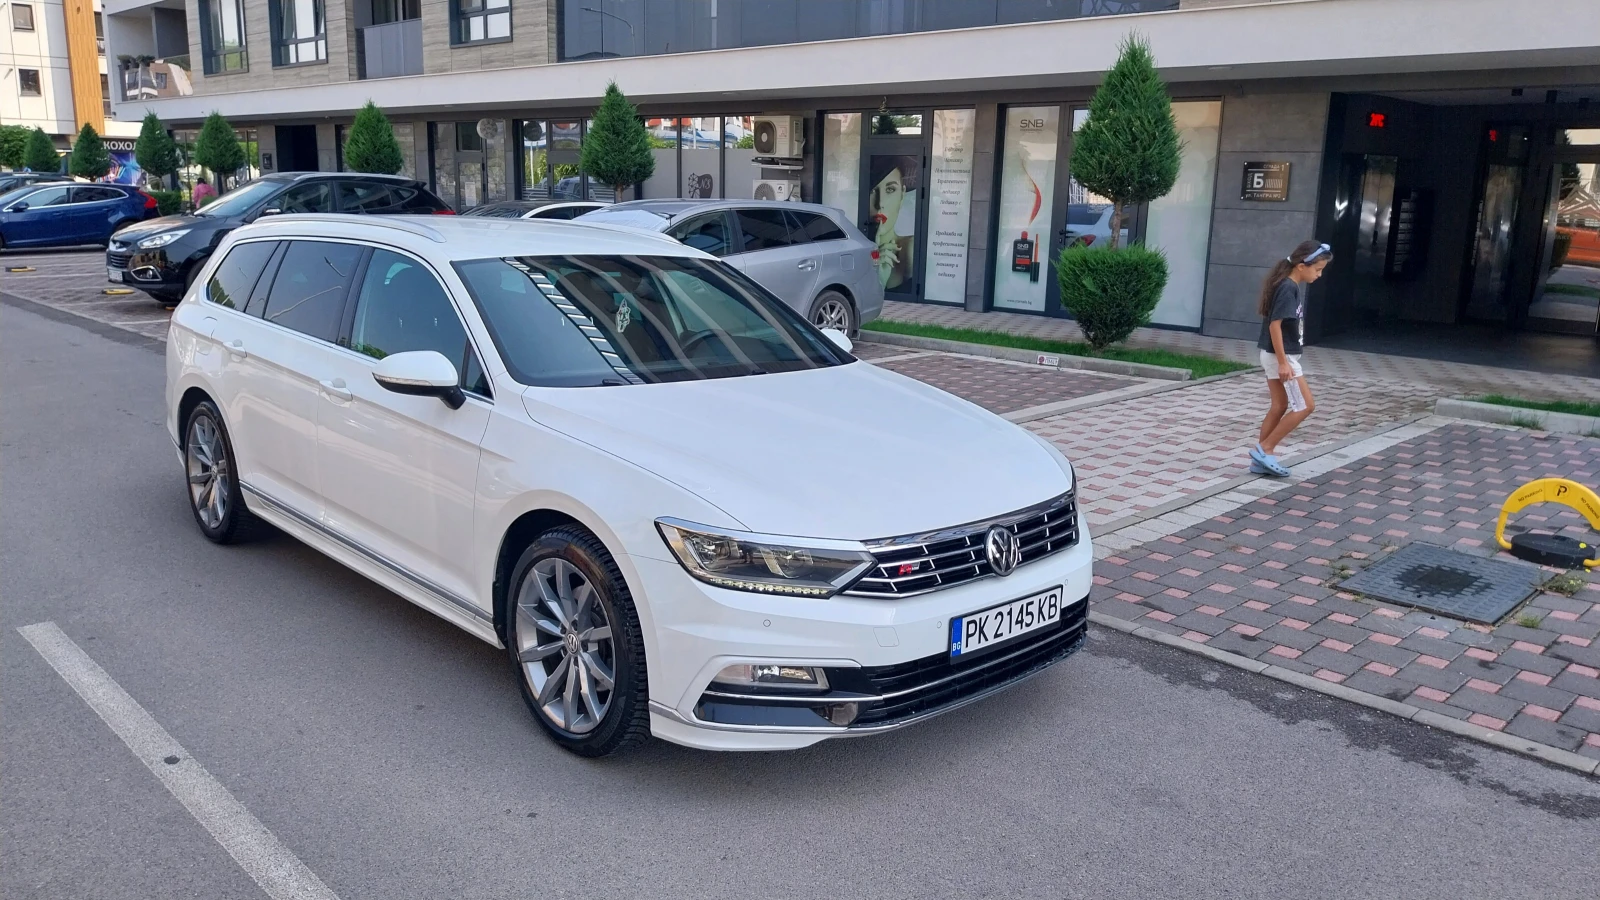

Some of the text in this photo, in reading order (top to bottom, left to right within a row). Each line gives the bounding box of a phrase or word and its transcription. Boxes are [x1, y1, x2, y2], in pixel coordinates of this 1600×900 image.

[1020, 118, 1044, 128] SNB
[1253, 173, 1264, 188] Б
[1557, 485, 1568, 496] P
[965, 593, 1058, 648] PK 2145 KB
[952, 642, 961, 652] BG
